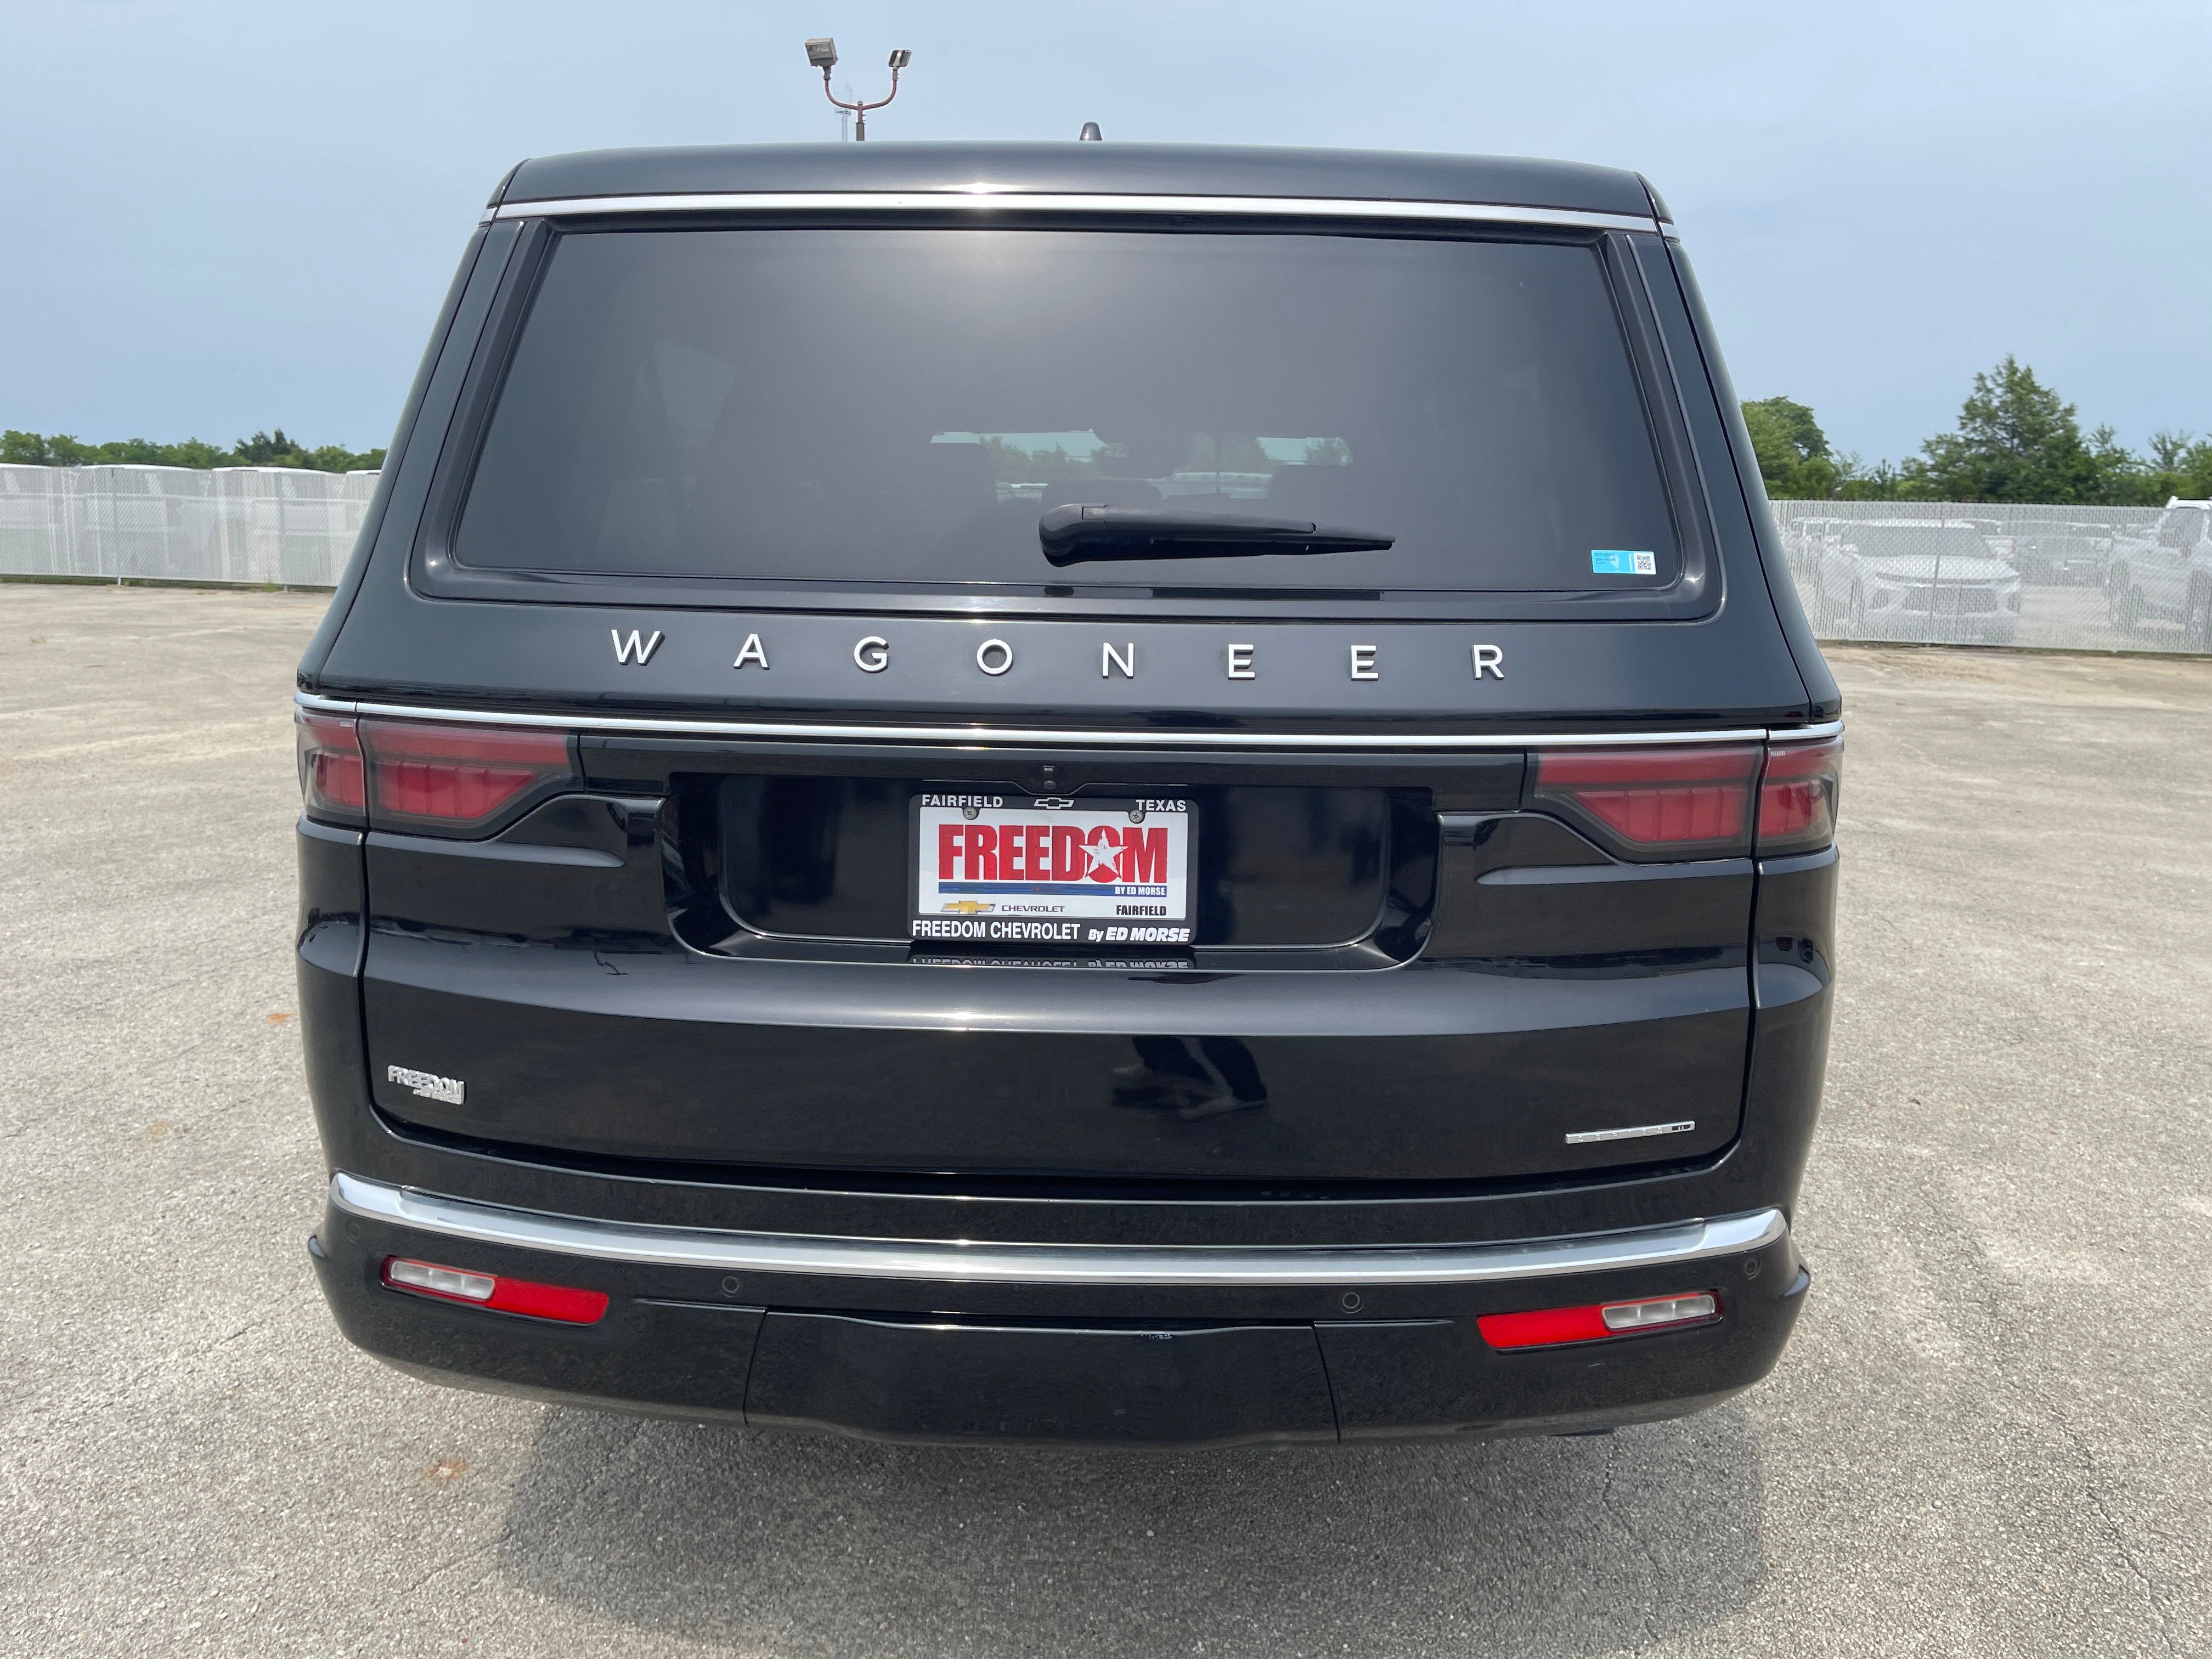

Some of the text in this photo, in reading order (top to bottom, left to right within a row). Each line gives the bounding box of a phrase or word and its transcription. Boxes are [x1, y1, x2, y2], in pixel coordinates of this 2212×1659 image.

[611, 629, 1504, 680] WAGONEER
[922, 794, 1003, 808] FAIRFIELD
[1136, 799, 1186, 811] TEXAS
[939, 824, 1168, 883] FREEDOM
[1115, 887, 1165, 896] BY ED MORSE
[1116, 905, 1166, 916] FAIRFIELD
[912, 920, 1190, 943] FREEDOM CHEVROLET By ED MORSE
